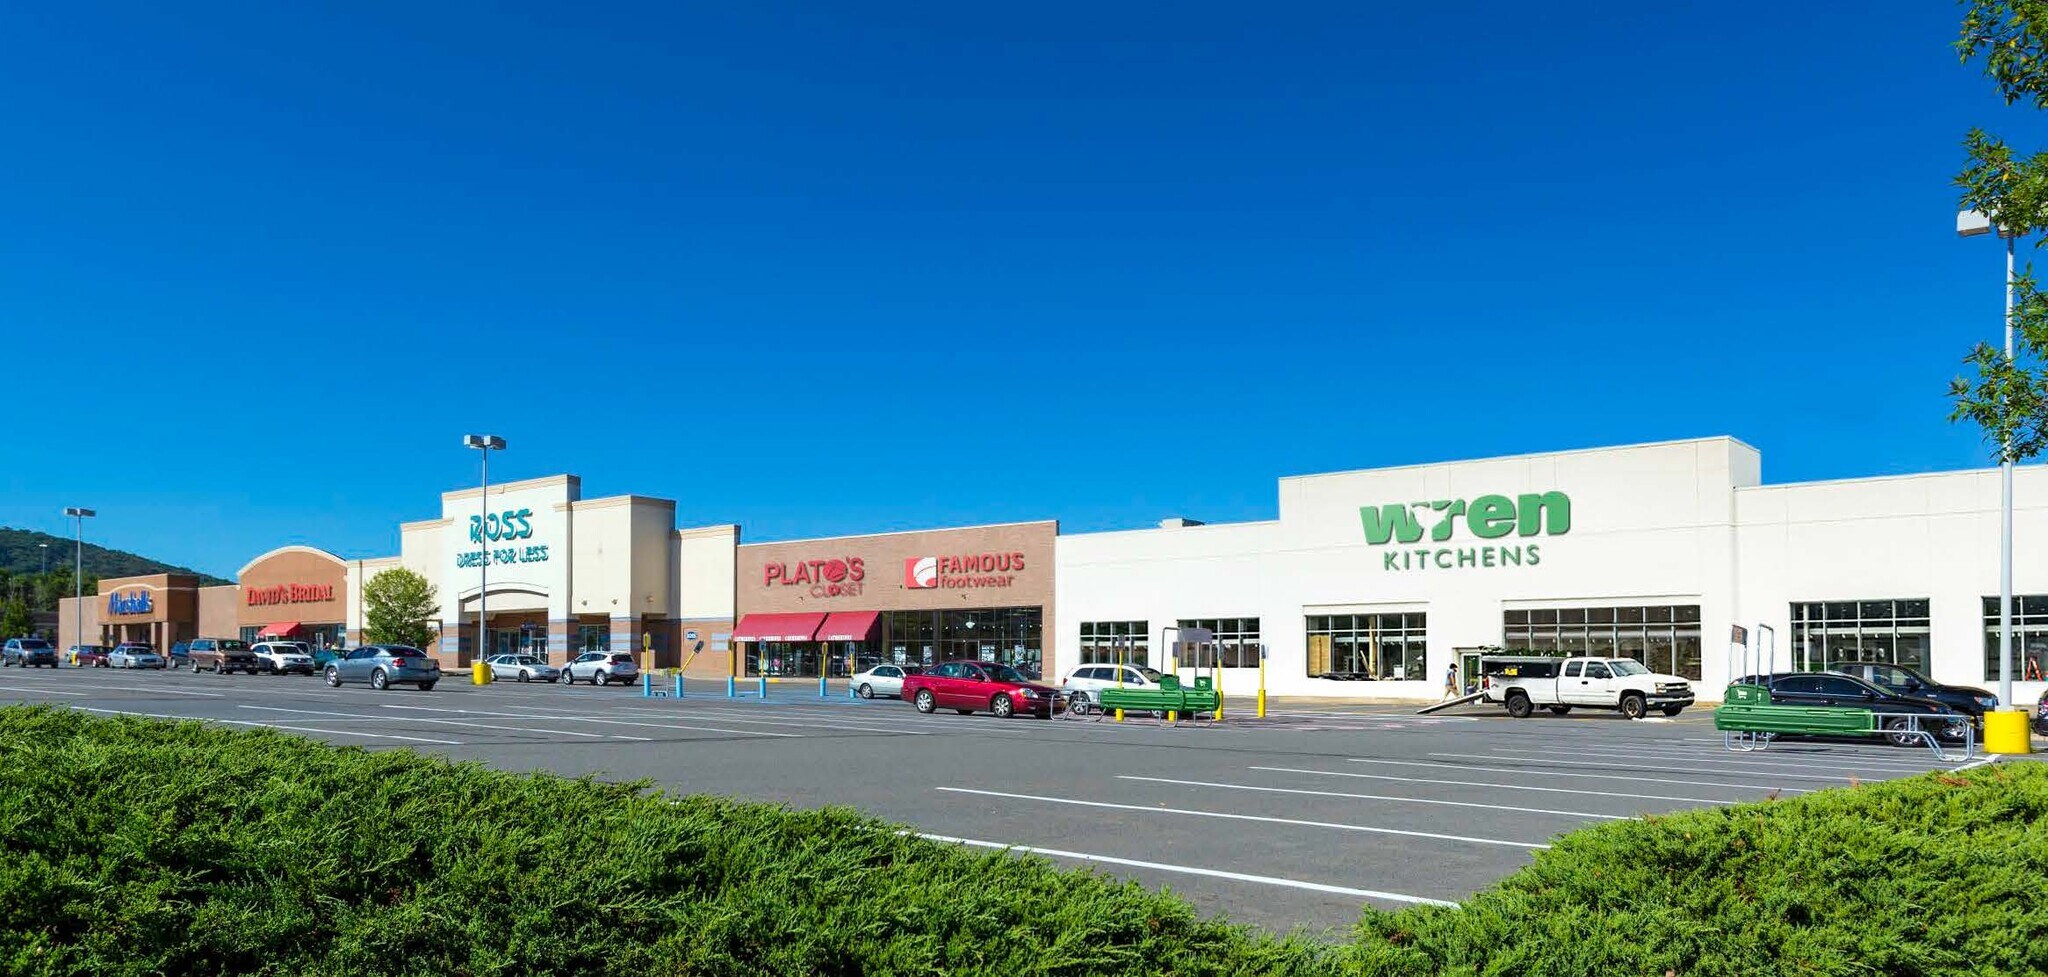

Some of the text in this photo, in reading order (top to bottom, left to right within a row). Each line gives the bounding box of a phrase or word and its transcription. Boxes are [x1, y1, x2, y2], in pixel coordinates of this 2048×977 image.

[470, 508, 532, 543] ROSS
[1360, 490, 1571, 545] wren
[457, 545, 548, 568] DRESS FOR LESS
[938, 552, 1025, 574] FAMOUS
[1384, 544, 1540, 571] KITCHENS
[763, 556, 865, 586] PLATO'S
[940, 574, 1015, 589] footwear
[290, 583, 335, 603] BRIDAL
[809, 581, 863, 598] CLOSET
